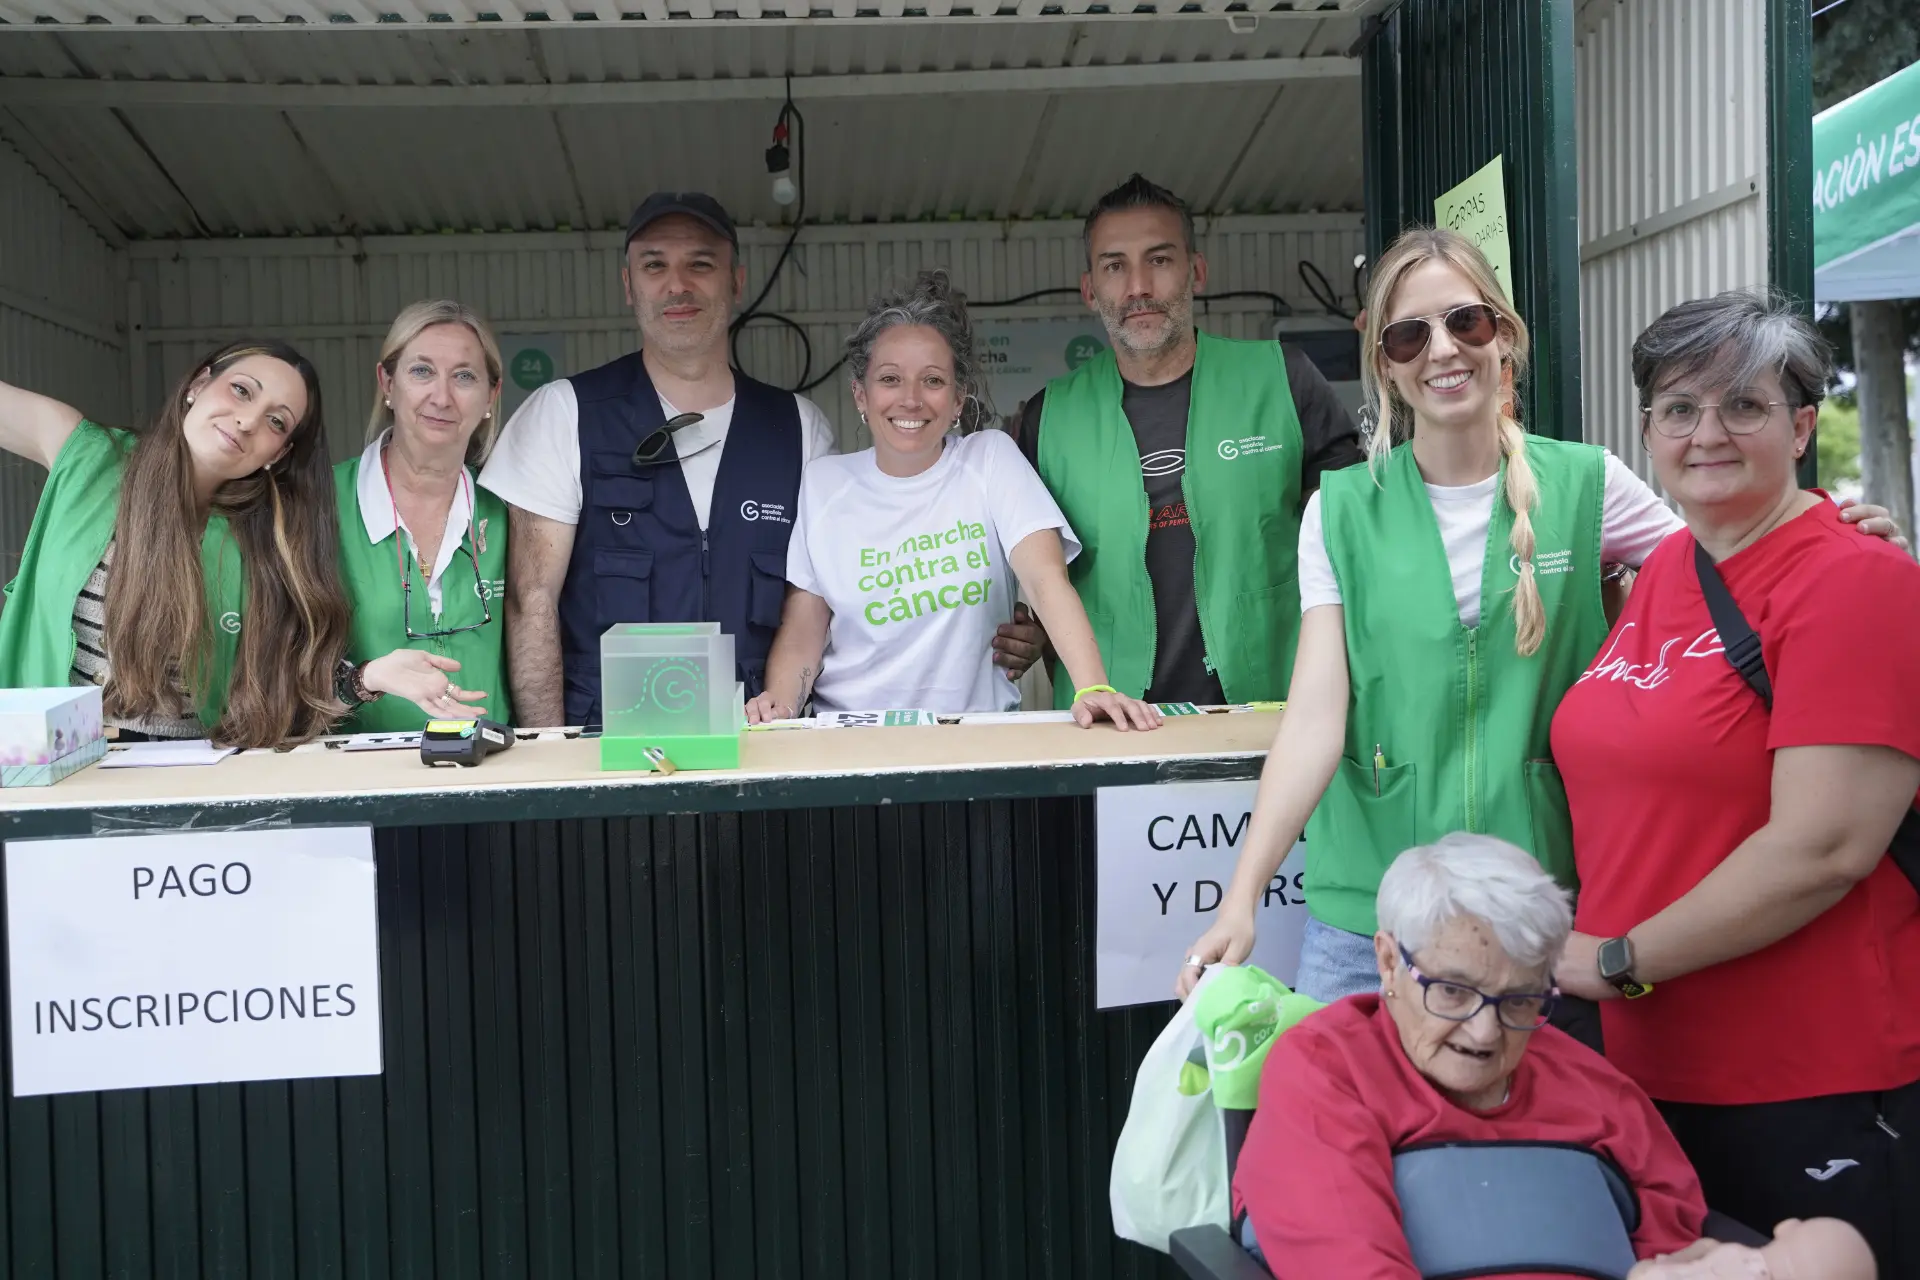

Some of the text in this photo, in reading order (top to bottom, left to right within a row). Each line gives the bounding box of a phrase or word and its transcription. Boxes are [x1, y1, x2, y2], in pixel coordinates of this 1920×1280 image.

[1445, 192, 1486, 231] GORRAS
[1472, 215, 1505, 248] DARIAS
[521, 358, 542, 373] 24
[1075, 344, 1095, 358] 24
[860, 518, 987, 567] En marcha
[1536, 549, 1572, 559] asociación
[858, 542, 991, 592] contra el
[1538, 558, 1569, 567] española
[1540, 566, 1562, 575] contra
[864, 577, 993, 626] cáncer
[132, 861, 252, 900] PAGO
[1152, 881, 1178, 916] Y
[35, 983, 357, 1035] INSCRIPCIONES
